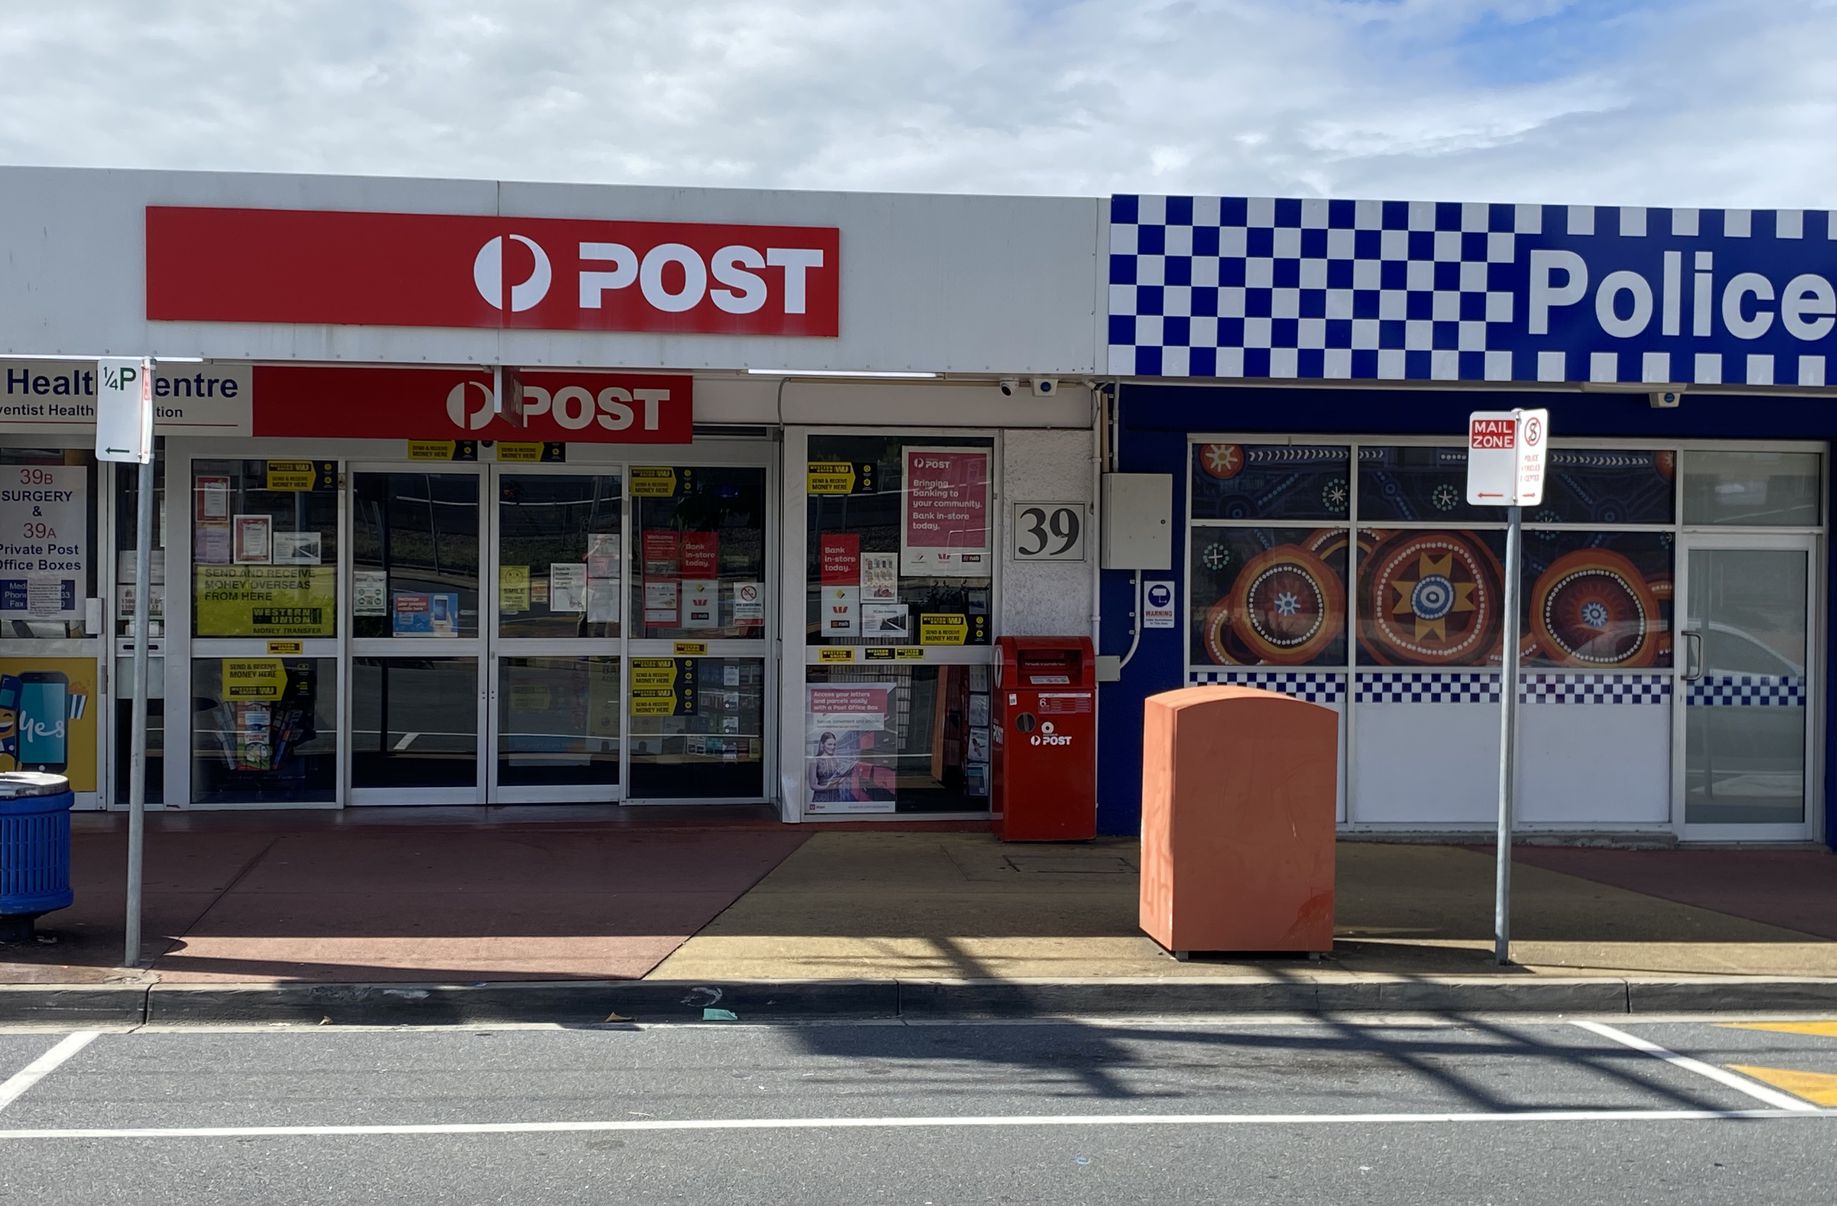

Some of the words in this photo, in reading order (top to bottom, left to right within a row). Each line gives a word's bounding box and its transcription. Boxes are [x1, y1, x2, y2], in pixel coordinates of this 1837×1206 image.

[579, 242, 824, 314] POST
[1528, 250, 1837, 341] Police
[7, 368, 98, 396] Healt
[155, 372, 238, 398] entre
[49, 404, 94, 416] Health
[522, 385, 670, 431] POST
[1475, 421, 1512, 433] MAIL
[1473, 435, 1513, 448] ZONE
[926, 461, 950, 469] POST
[20, 469, 53, 485] 39B
[913, 480, 949, 490] Bringing
[1, 490, 73, 502] SURGERY
[913, 489, 948, 498] banking
[912, 500, 932, 508] your
[934, 500, 983, 510] community.
[32, 506, 42, 517] &
[912, 512, 935, 520] Bank
[936, 512, 970, 520] in-store
[23, 523, 57, 539] 39A
[912, 522, 941, 531] today.
[1018, 507, 1080, 556] 39
[48, 544, 79, 555] Post
[824, 546, 846, 554] Bank
[686, 551, 716, 559] in-store
[39, 560, 81, 571] Boxes
[686, 560, 711, 568] today.
[825, 564, 851, 572] today.
[205, 568, 236, 578] SEND
[240, 568, 265, 578] AND
[267, 568, 316, 578] RECEIVE
[250, 580, 310, 590] OVERSEAS
[205, 592, 238, 601] FROM
[241, 592, 272, 601] HERE
[254, 608, 311, 616] WESTERN
[272, 616, 311, 624] UNION
[1042, 736, 1072, 746] POST
